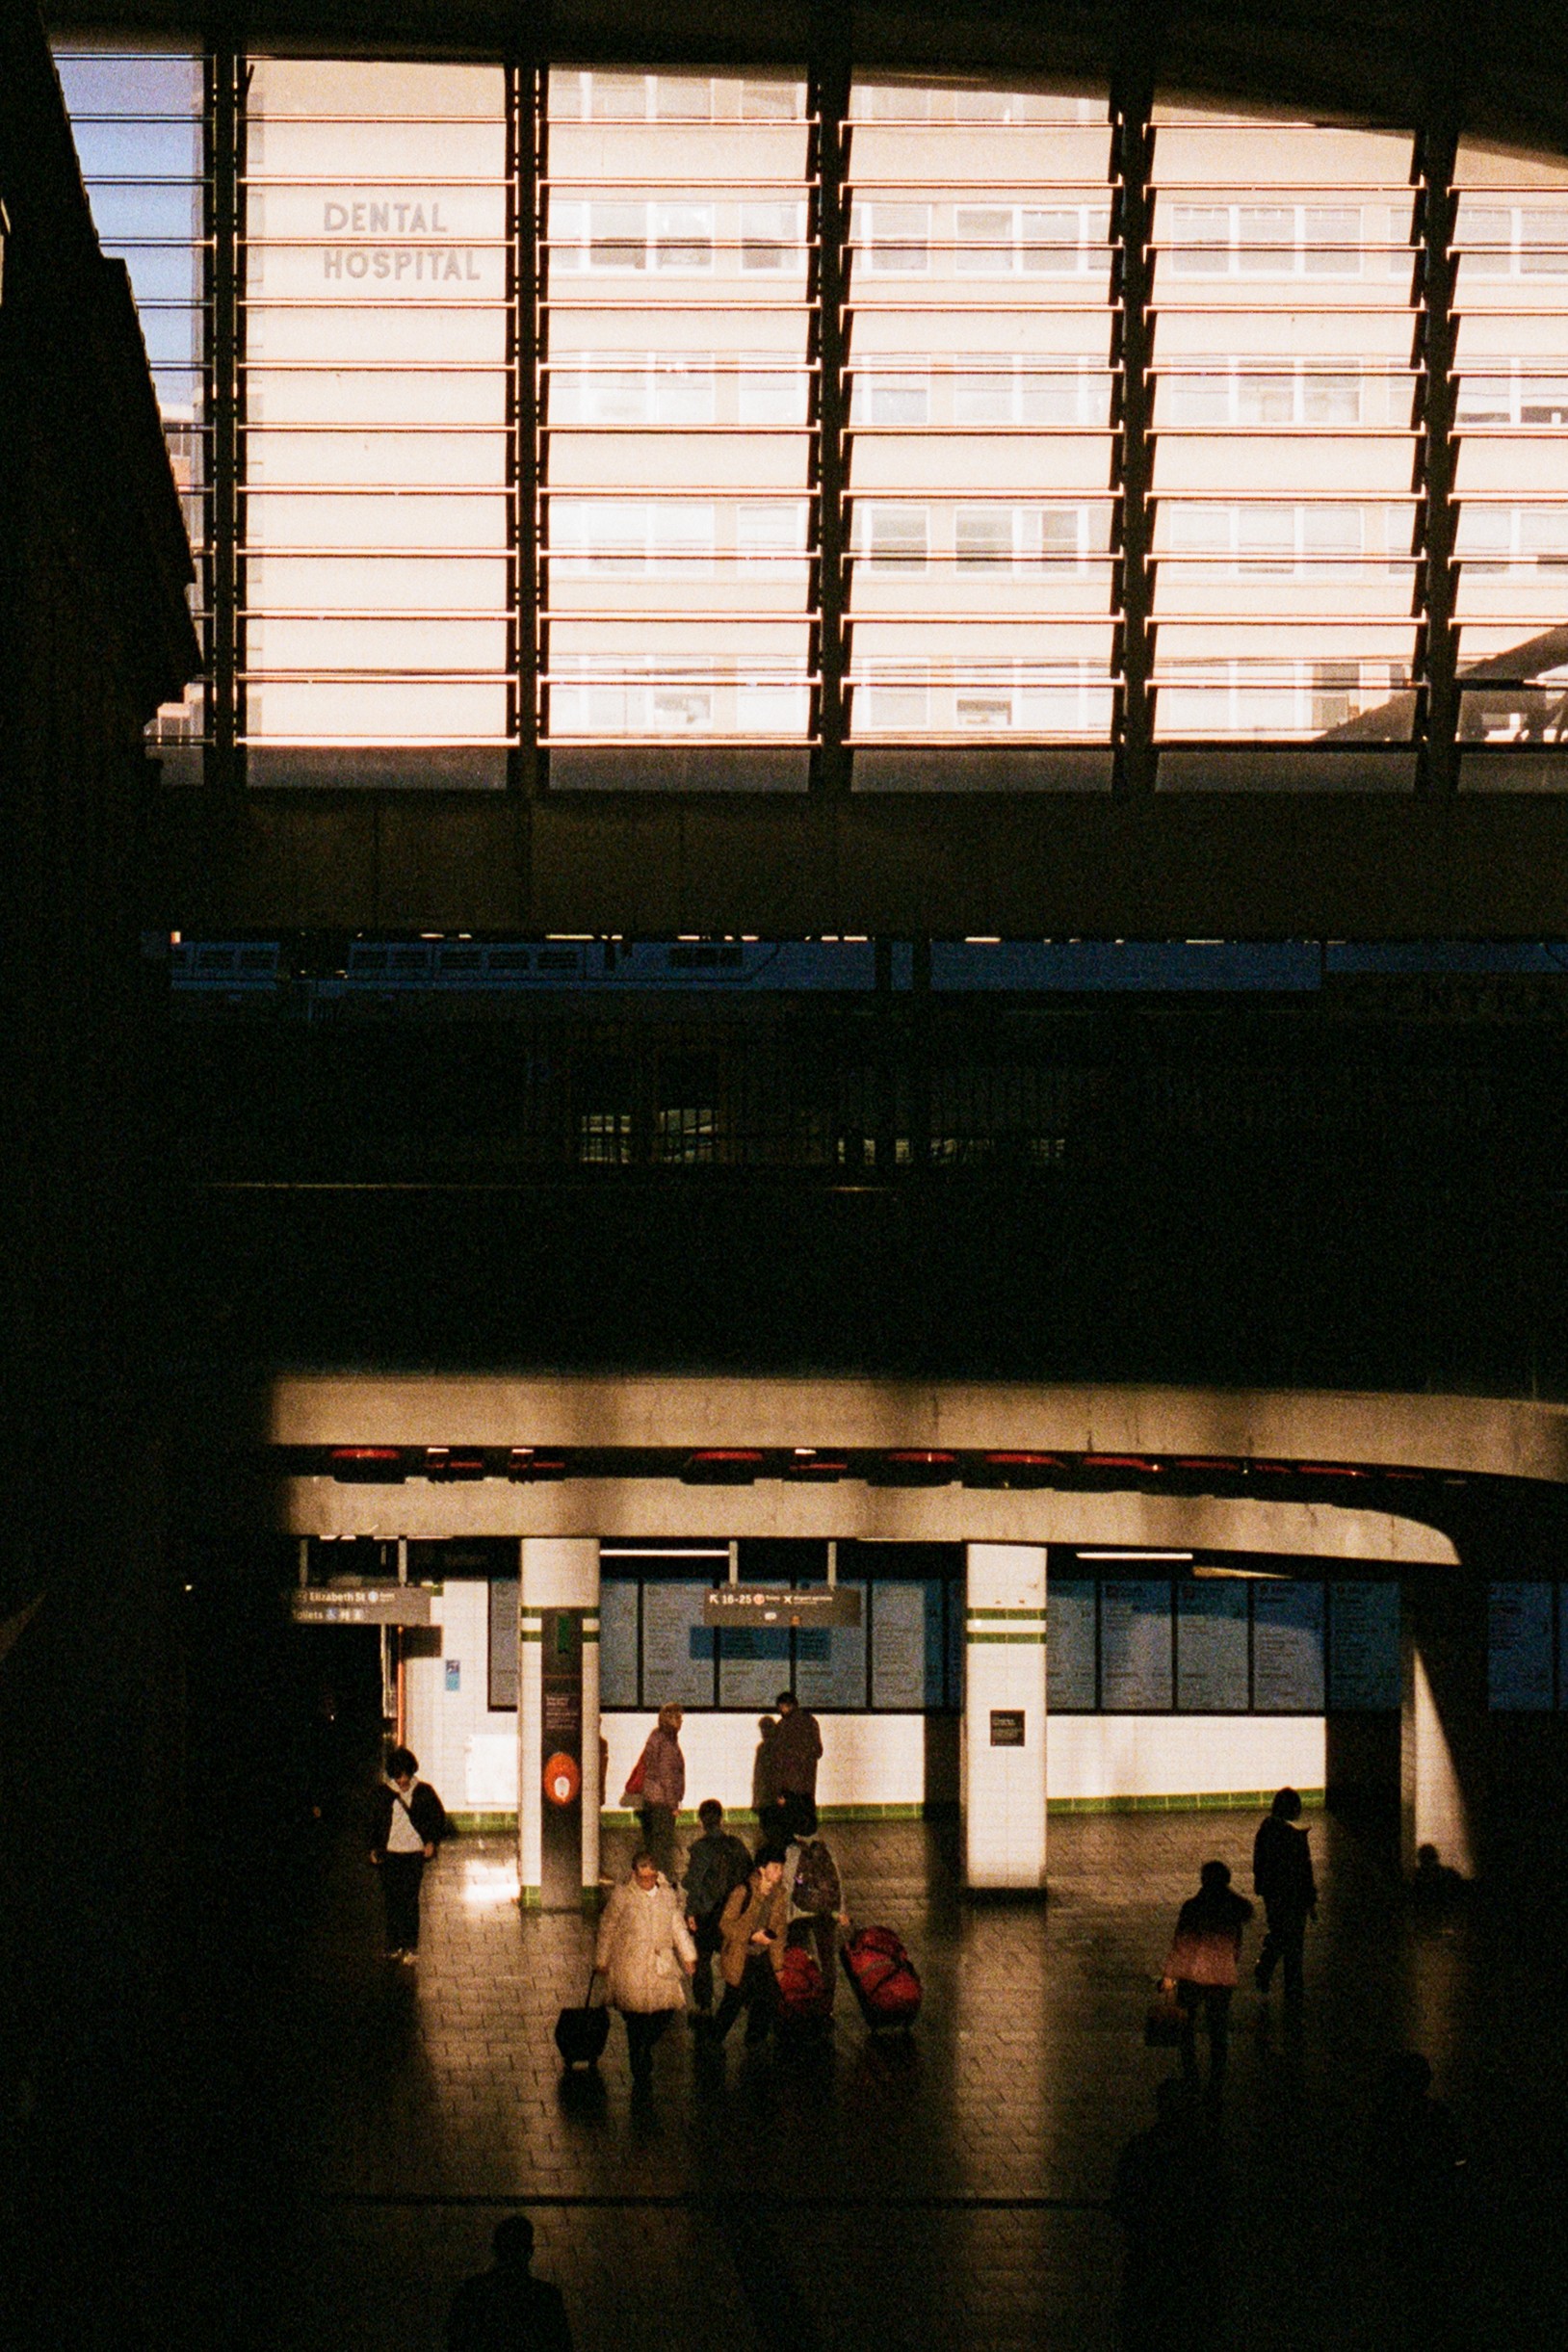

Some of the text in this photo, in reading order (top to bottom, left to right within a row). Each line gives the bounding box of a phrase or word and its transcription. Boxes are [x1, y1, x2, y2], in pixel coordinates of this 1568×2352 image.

[324, 201, 448, 232] DENTAL
[324, 249, 481, 280] HOSPITAL
[309, 1590, 354, 1603] Elizabeth
[354, 1590, 366, 1603] St
